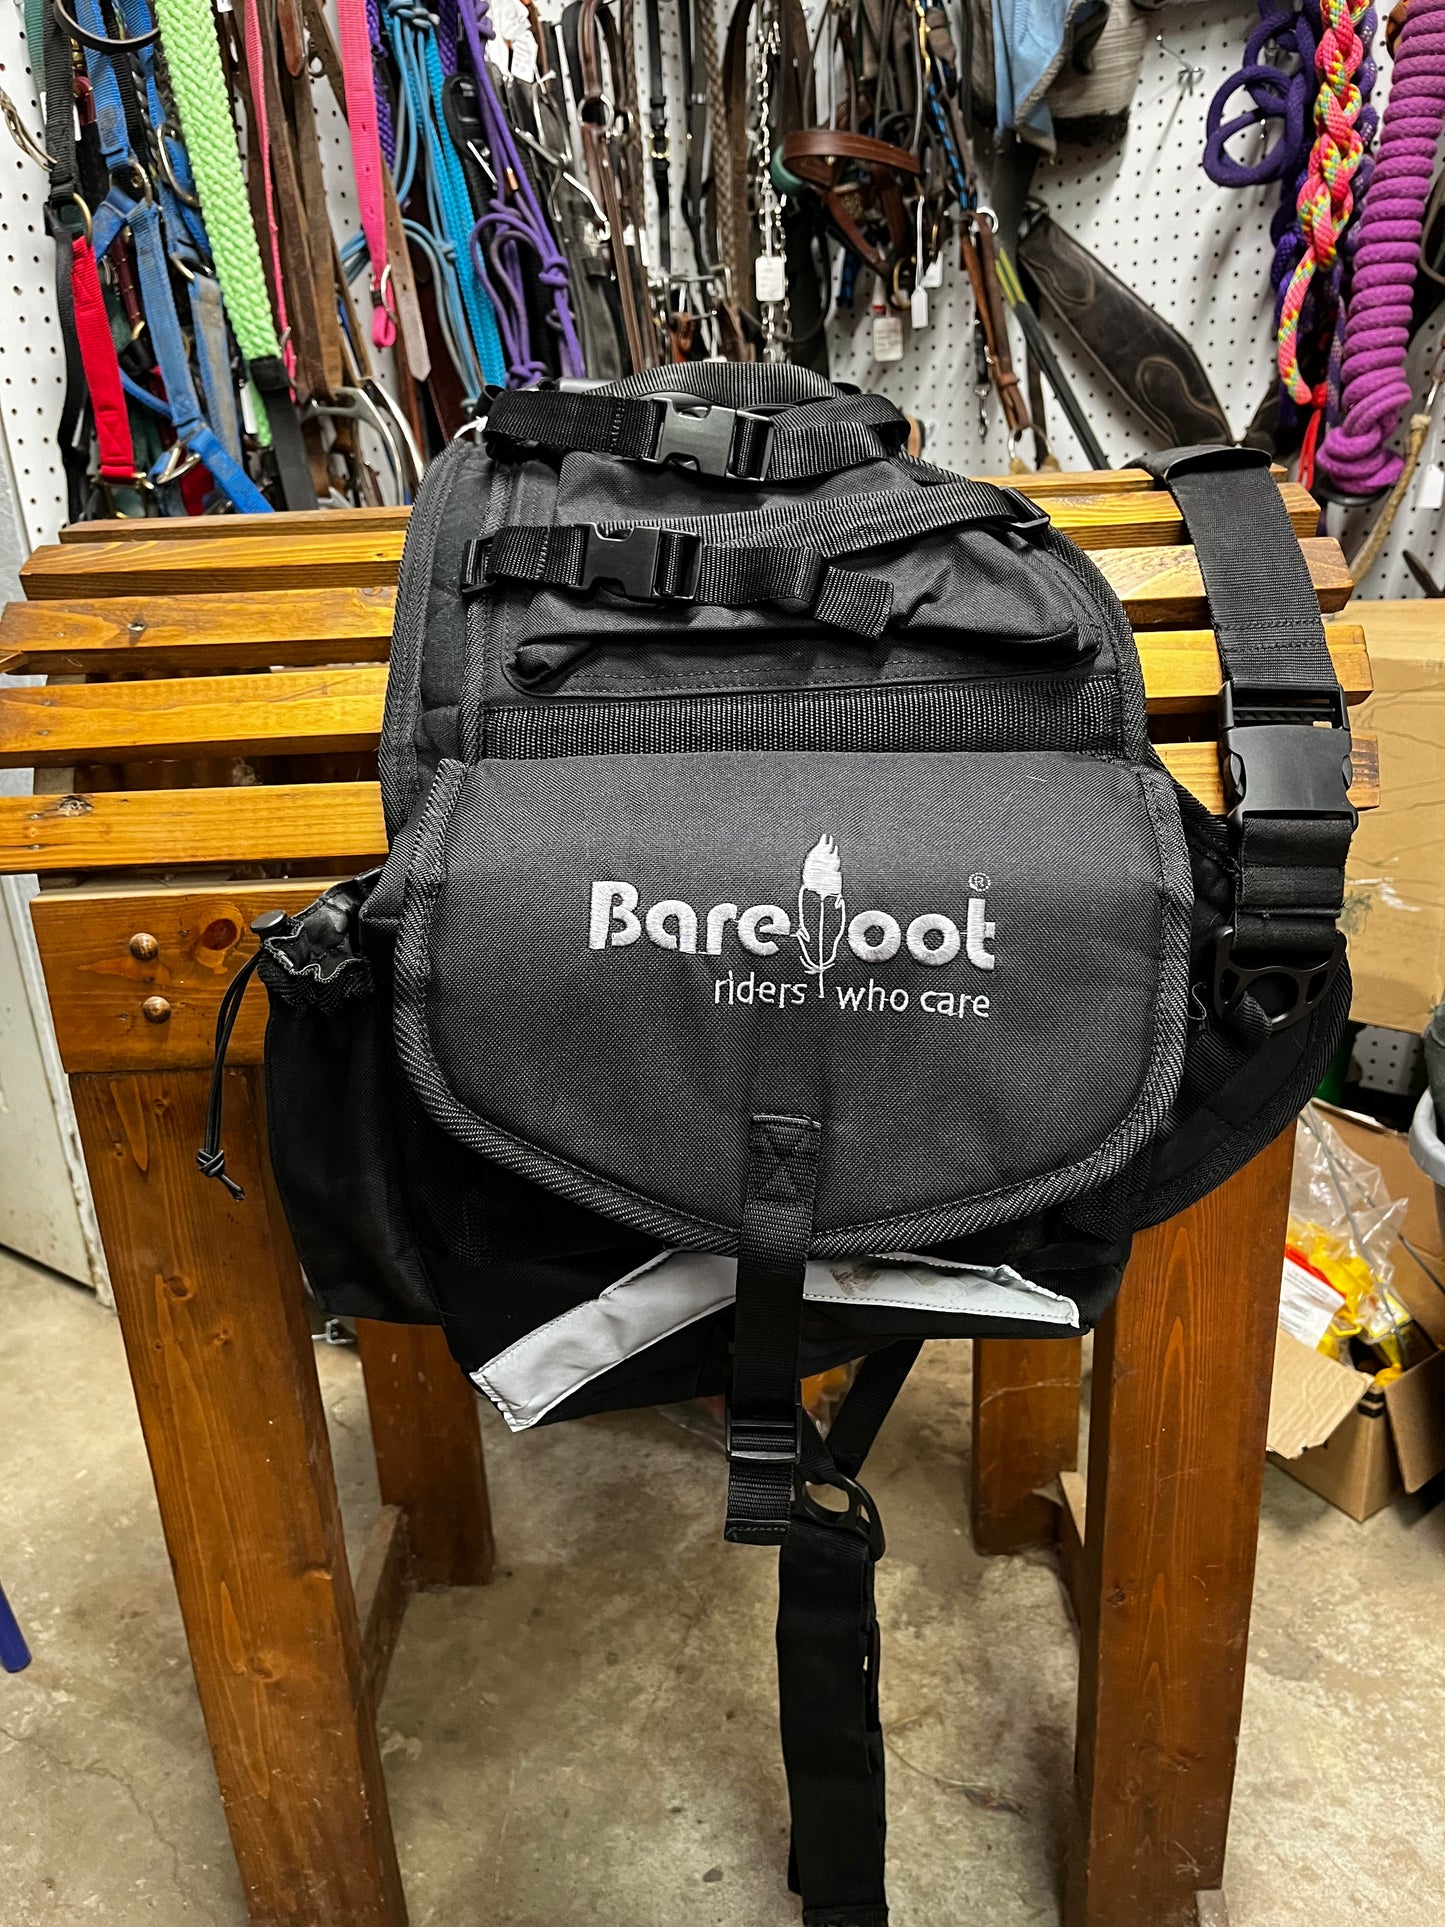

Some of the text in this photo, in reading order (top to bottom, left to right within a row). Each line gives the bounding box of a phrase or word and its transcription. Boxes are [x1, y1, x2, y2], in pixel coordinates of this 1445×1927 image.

[714, 970, 990, 1019] riders who care
